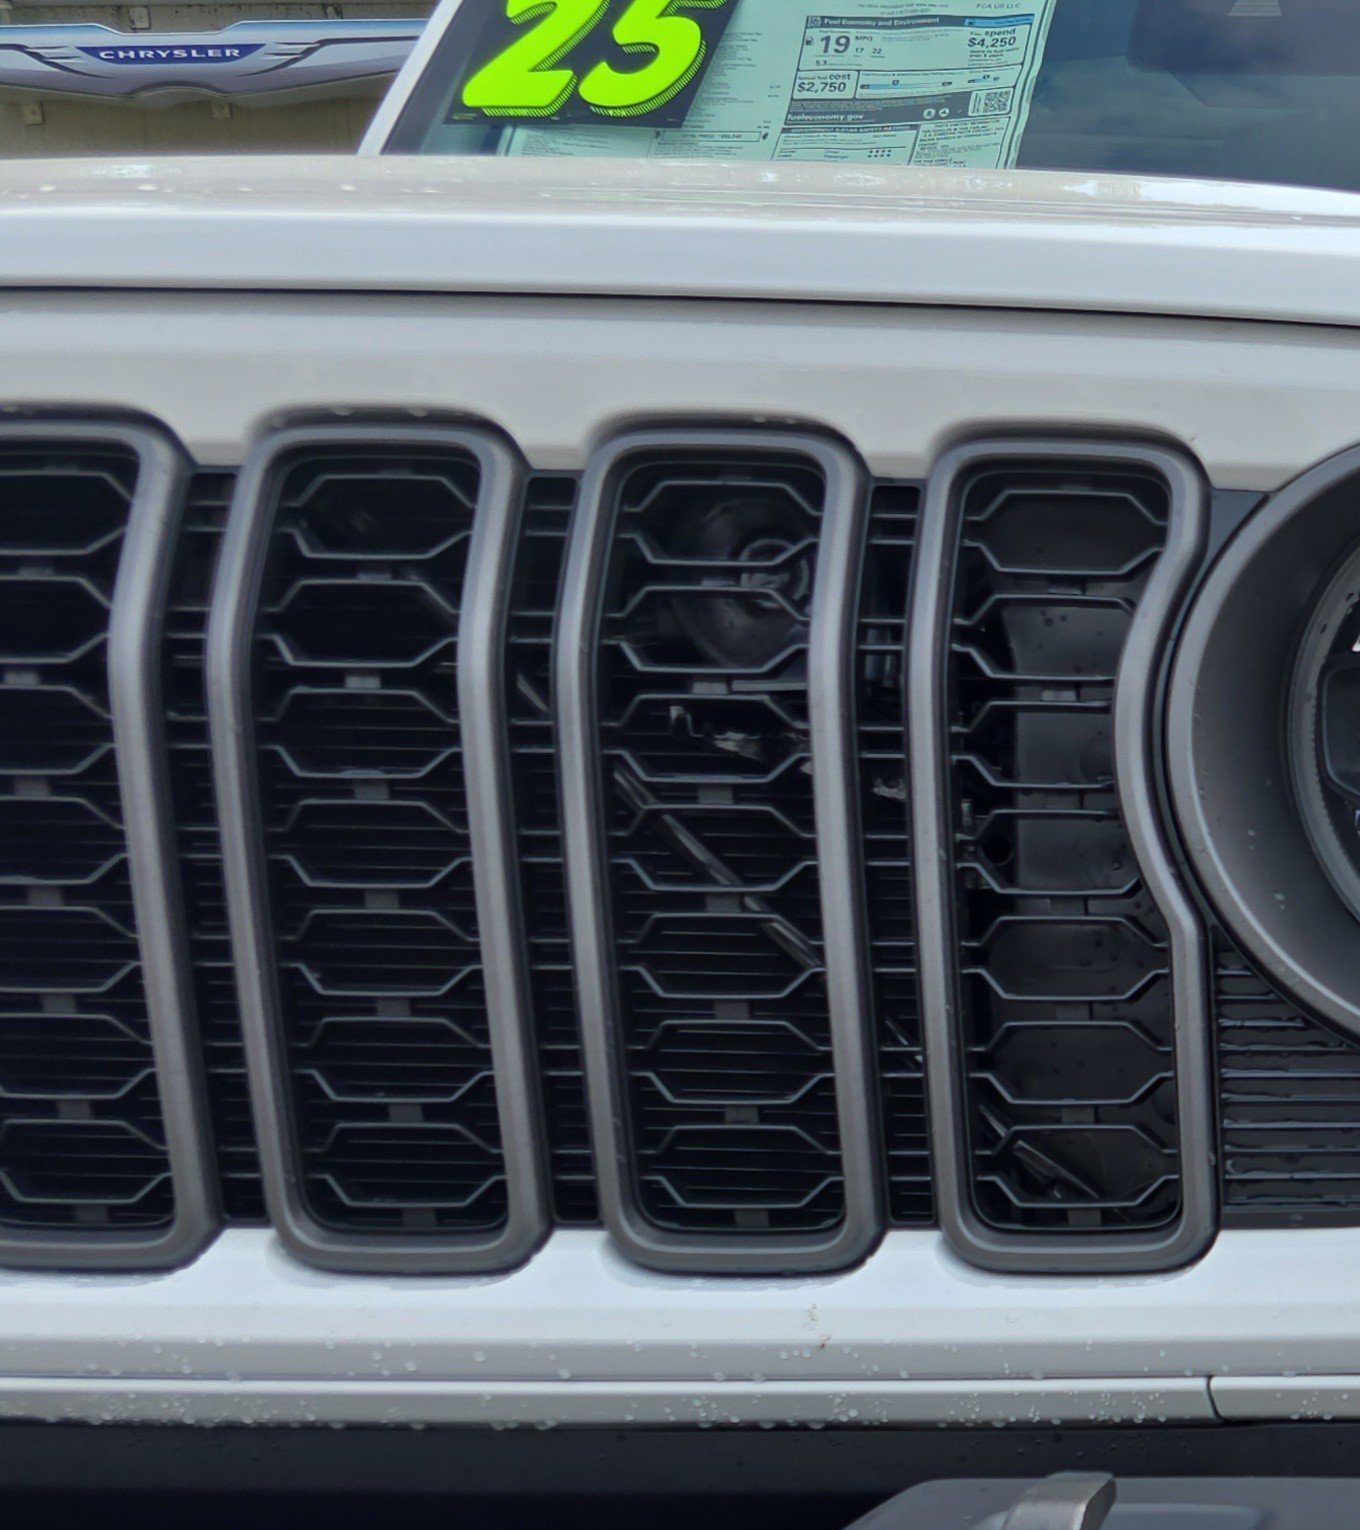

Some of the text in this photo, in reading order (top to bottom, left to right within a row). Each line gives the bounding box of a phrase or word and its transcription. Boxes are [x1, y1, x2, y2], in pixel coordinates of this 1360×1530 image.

[984, 28, 1016, 37] spend
[821, 35, 851, 54] 19
[967, 36, 1017, 49] $4,250
[99, 48, 240, 60] CHRYSLER
[463, 0, 727, 117] 25
[829, 73, 851, 81] cost
[797, 82, 847, 94] $2,750
